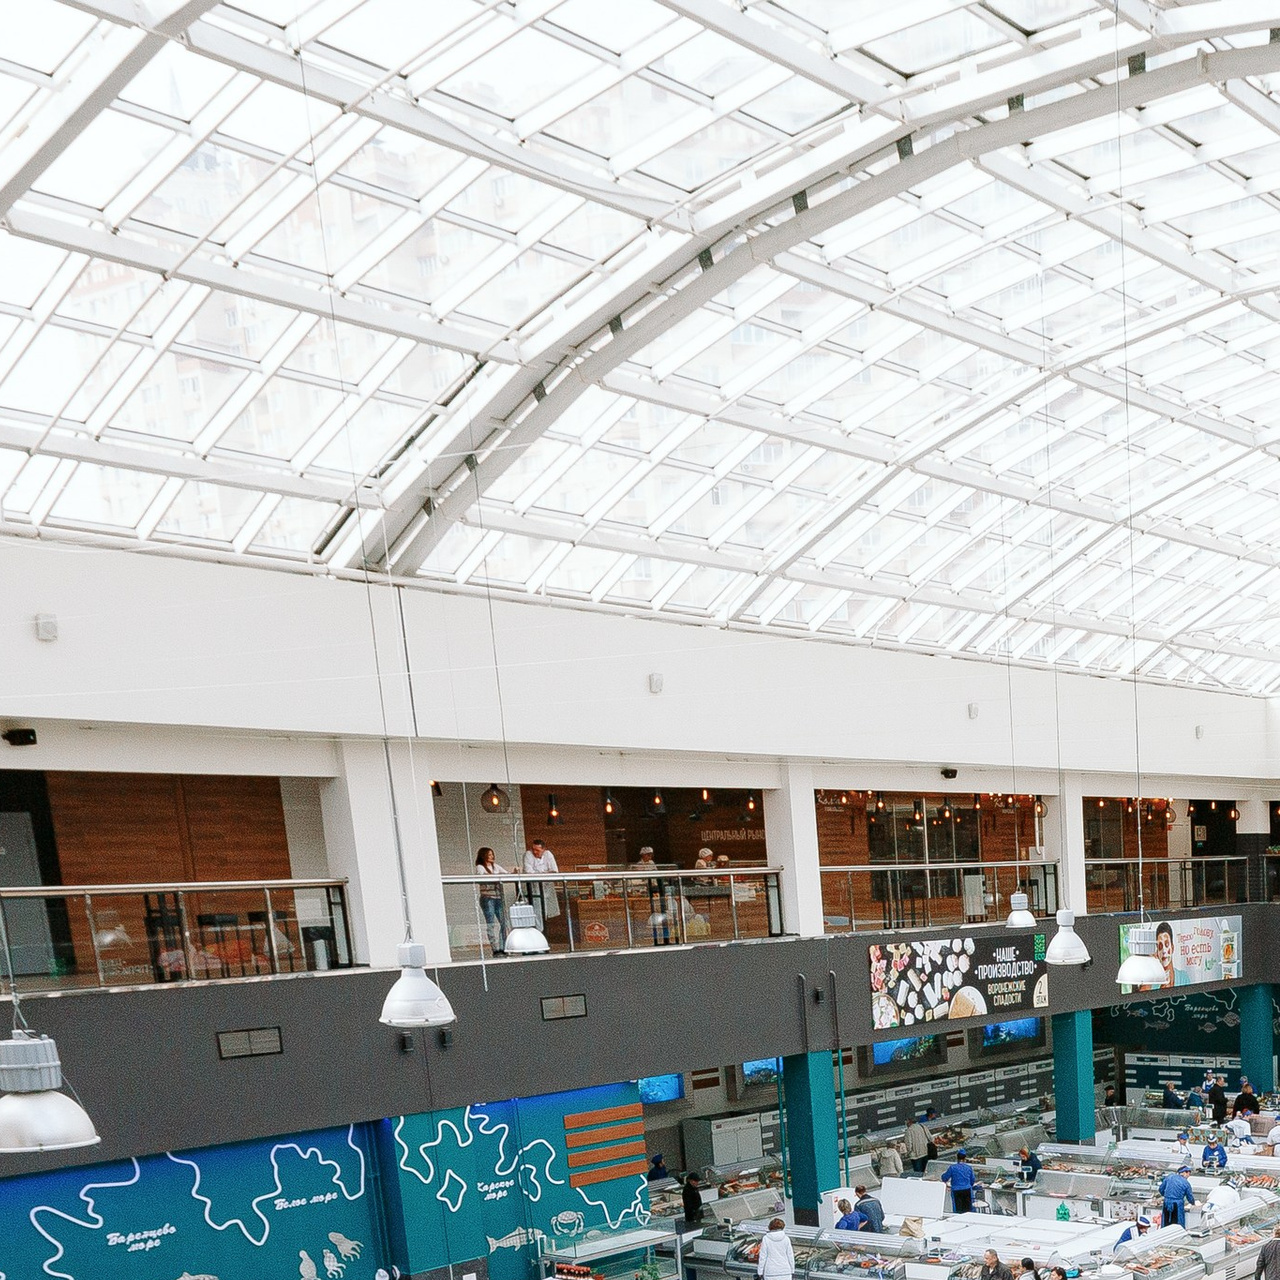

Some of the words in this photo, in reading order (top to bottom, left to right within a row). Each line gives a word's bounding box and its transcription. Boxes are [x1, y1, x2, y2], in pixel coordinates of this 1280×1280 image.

[701, 828, 746, 841] ЦЕНТРАЛЬНЫЙ
[747, 829, 766, 840] РЫНО
[996, 946, 1016, 962] НАШЕ
[1180, 945, 1190, 955] но
[977, 961, 1035, 980] ПРОИЗВОДСТВО
[993, 993, 1022, 1006] СЛАДОСТИ
[273, 1197, 307, 1211] Белое
[309, 1191, 338, 1204] море
[127, 1237, 161, 1253] море
